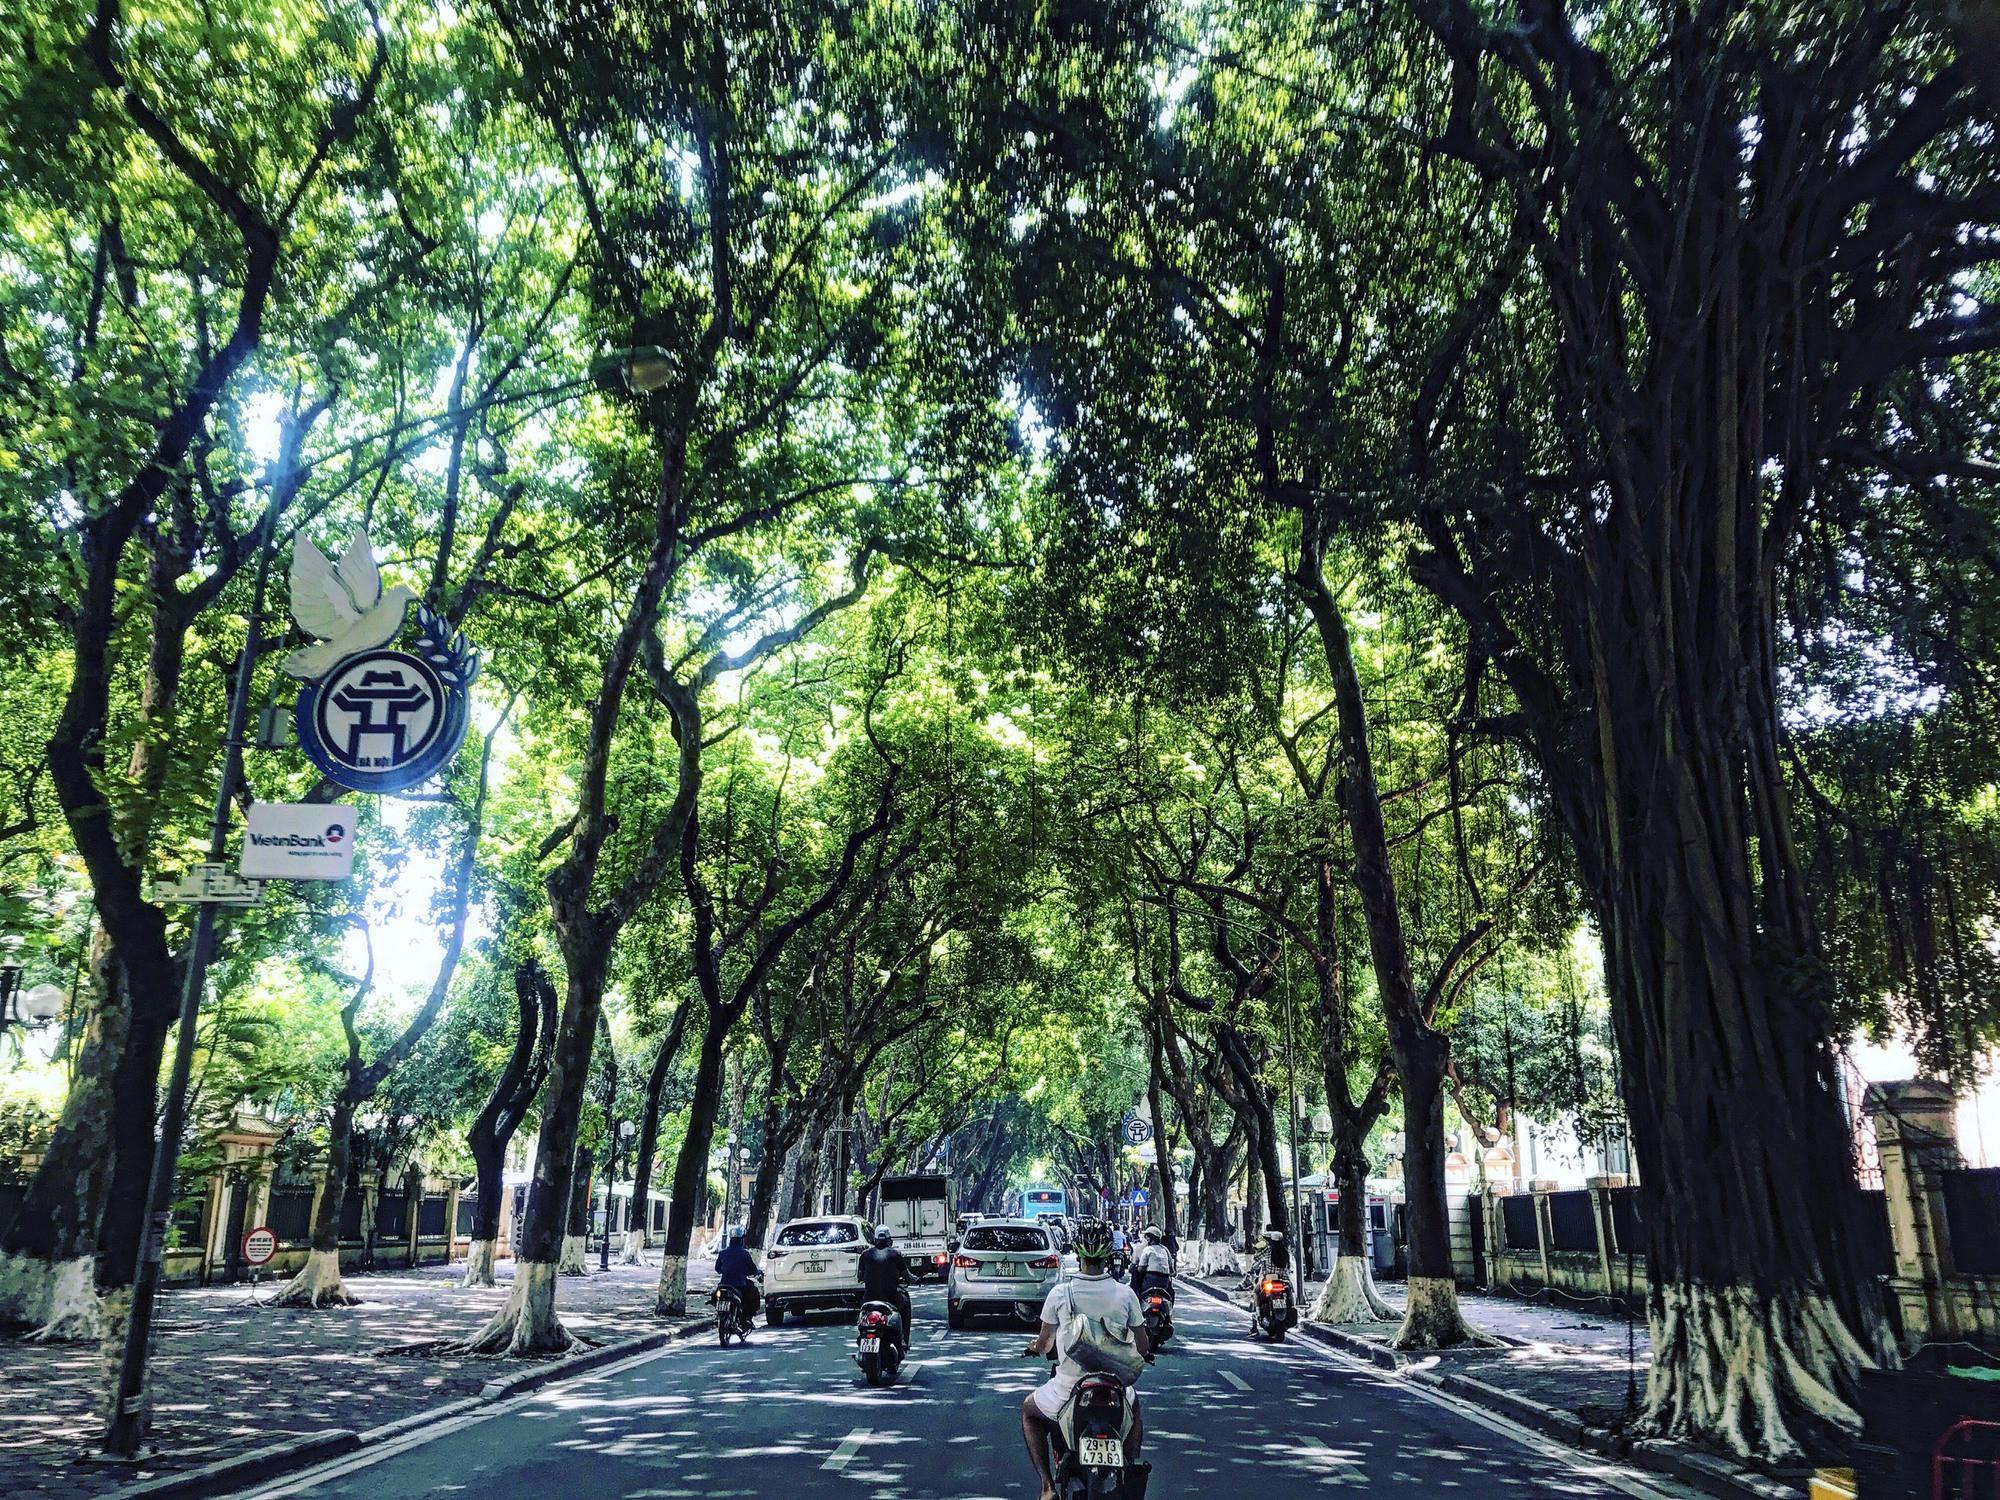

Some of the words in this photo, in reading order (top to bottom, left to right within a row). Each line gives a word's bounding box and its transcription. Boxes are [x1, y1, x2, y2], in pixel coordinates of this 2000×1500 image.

[250, 833, 326, 848] VietinBank
[1086, 1439, 1117, 1452] 29-Y3
[1083, 1452, 1121, 1465] 473.63
